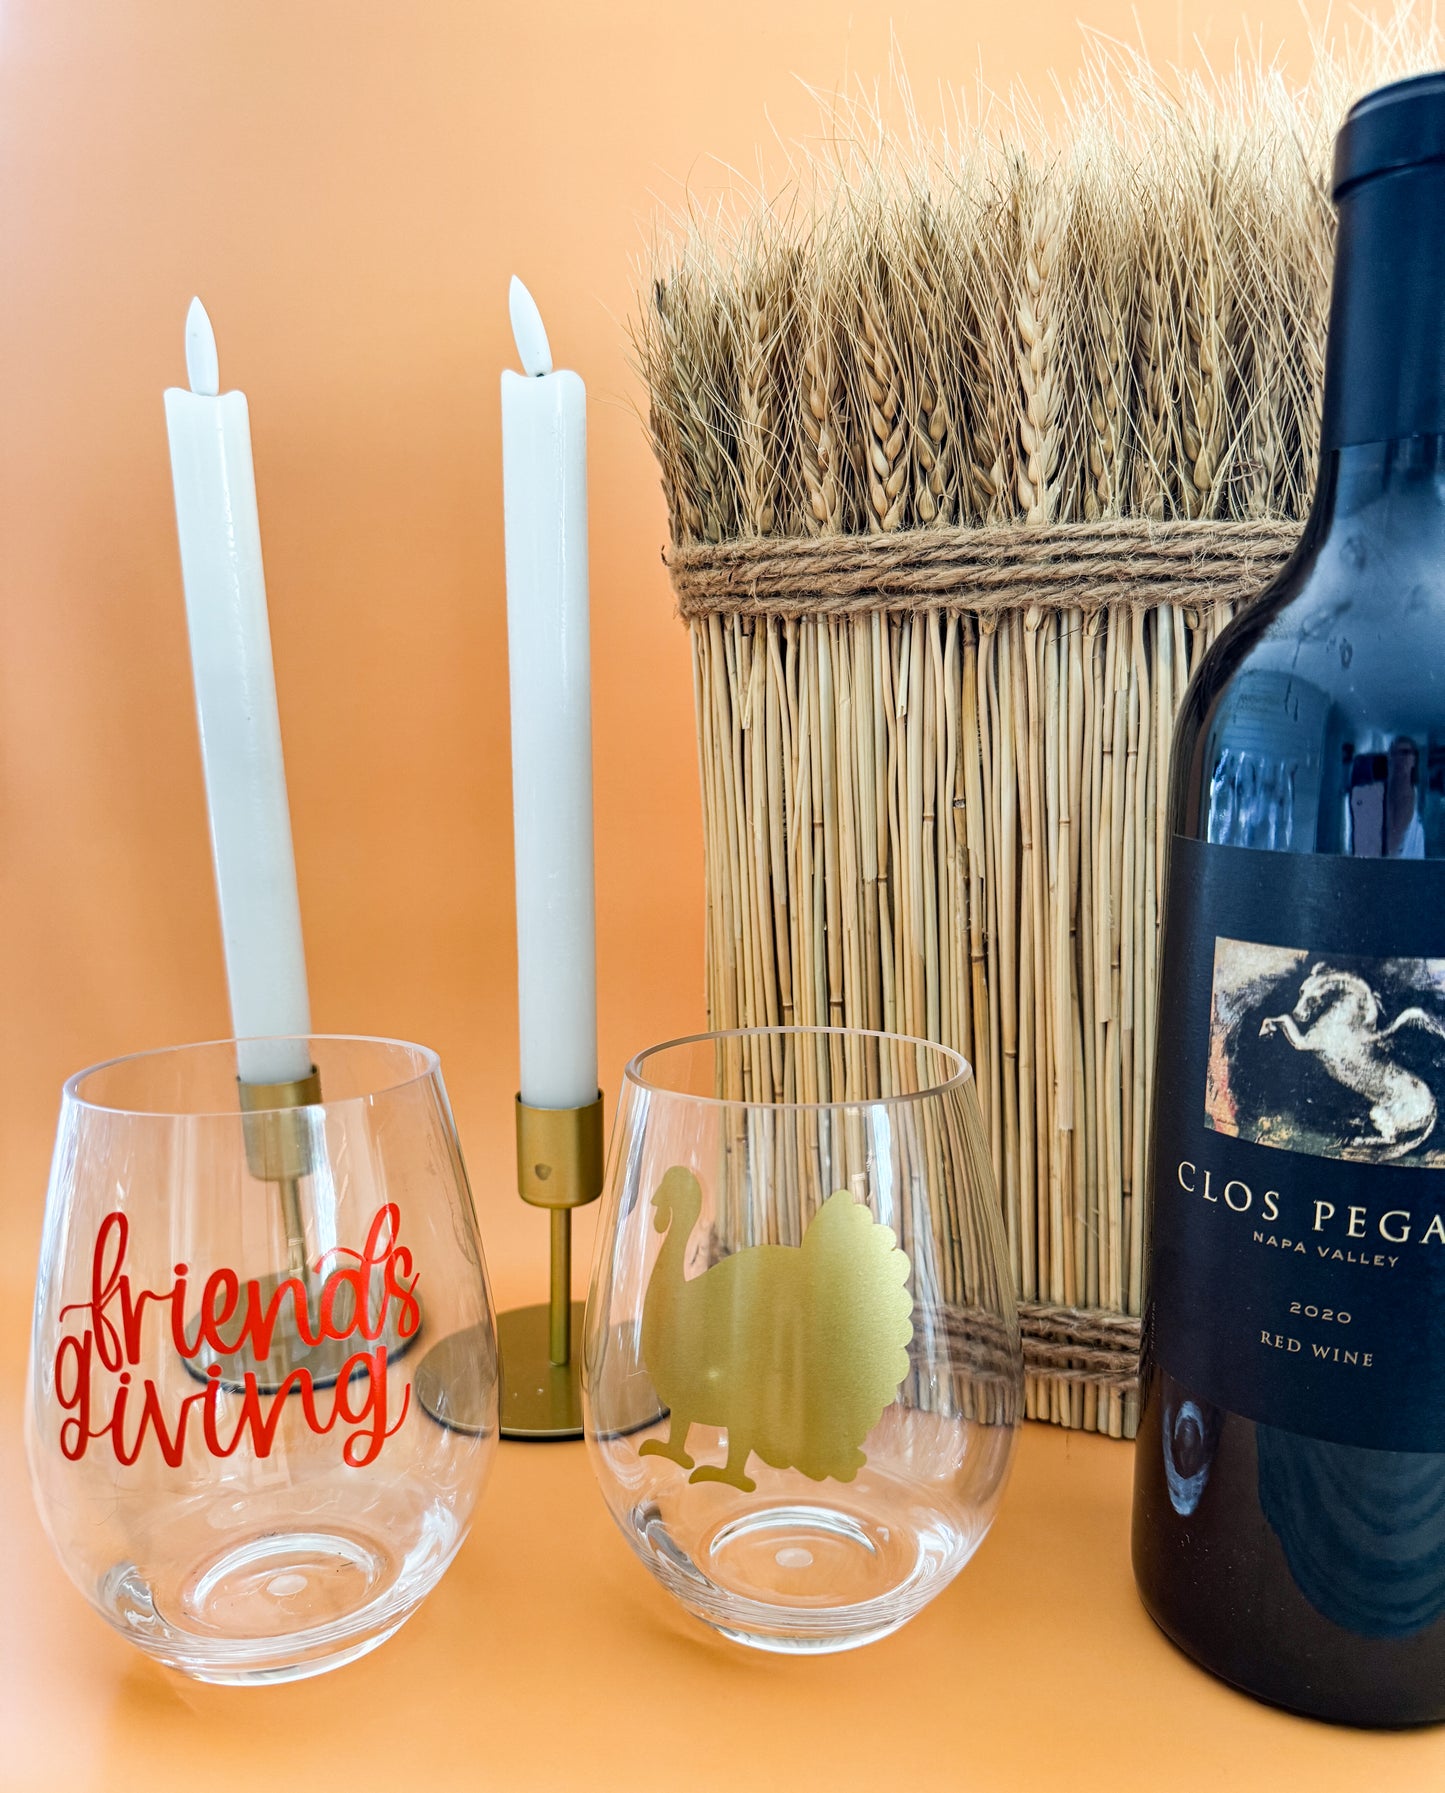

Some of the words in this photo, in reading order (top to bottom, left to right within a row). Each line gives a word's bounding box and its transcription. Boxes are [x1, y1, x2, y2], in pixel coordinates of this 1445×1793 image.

[1177, 1160, 1281, 1221] CLOS
[1253, 1230, 1307, 1254] NAPA
[1317, 1246, 1399, 1268] VALLEY
[60, 1203, 420, 1372] friends
[1289, 1302, 1352, 1324] 2020
[1260, 1330, 1301, 1353] RED
[1311, 1343, 1373, 1367] WINE
[55, 1330, 411, 1468] giving
